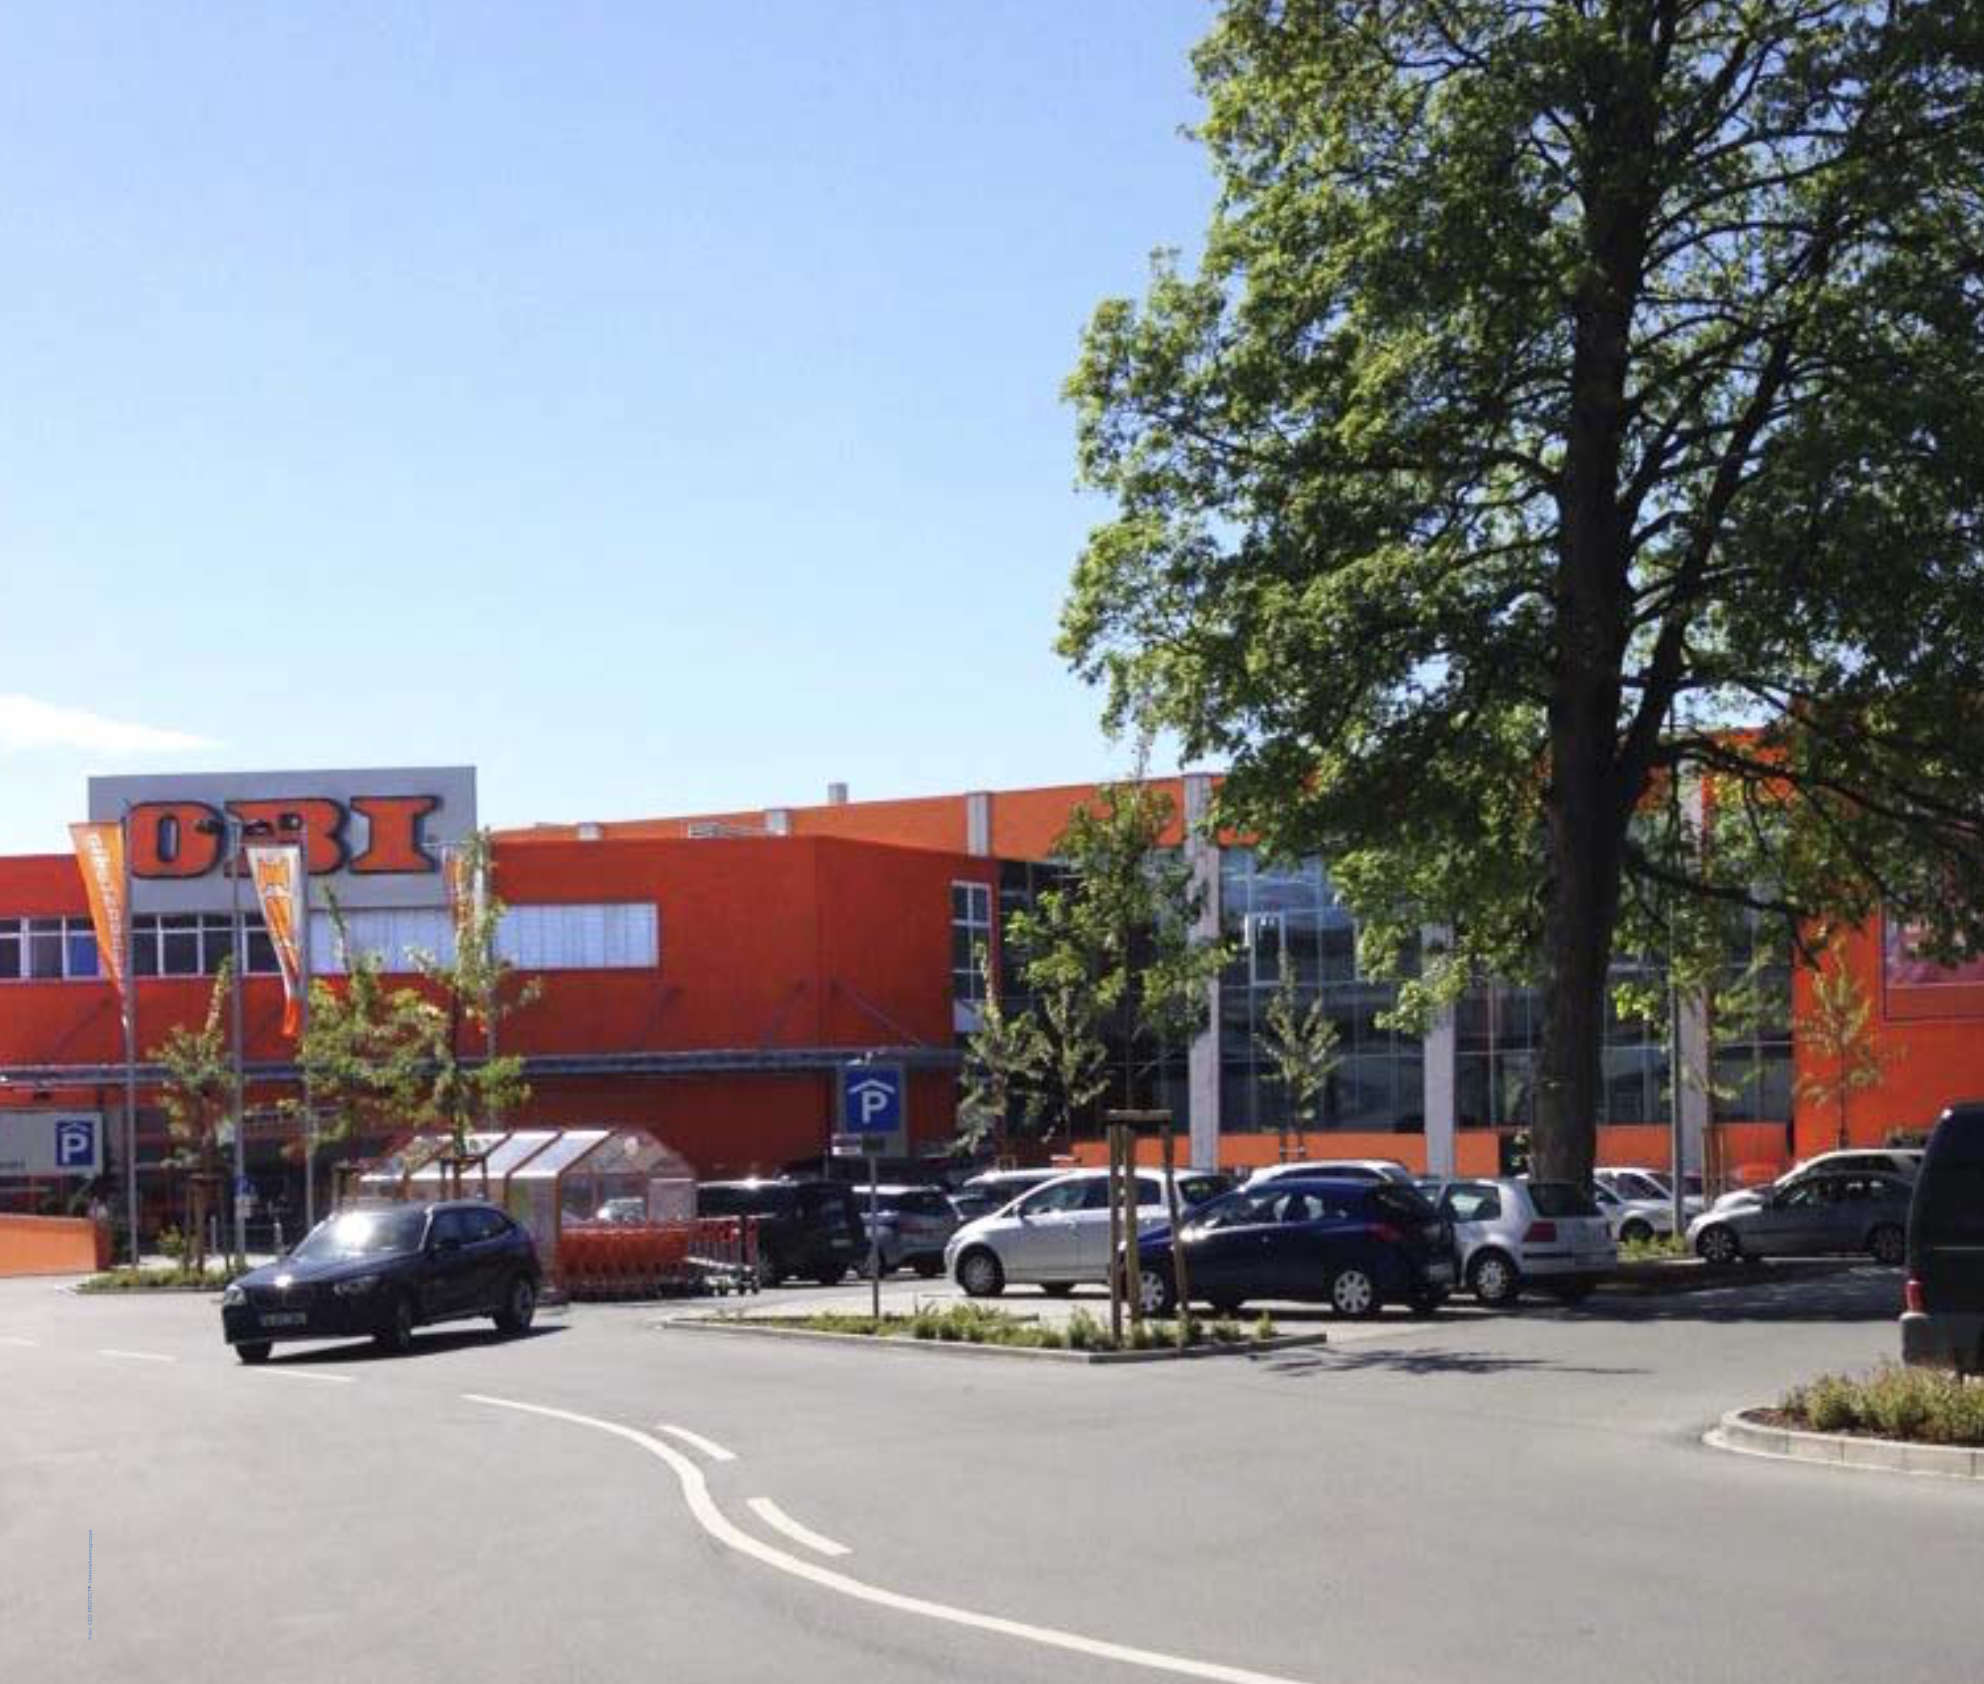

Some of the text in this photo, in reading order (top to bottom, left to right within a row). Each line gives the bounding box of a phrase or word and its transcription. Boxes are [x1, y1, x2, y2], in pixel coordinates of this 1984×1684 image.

[130, 795, 442, 879] OBI
[861, 1090, 888, 1124] P
[62, 1132, 89, 1164] P
